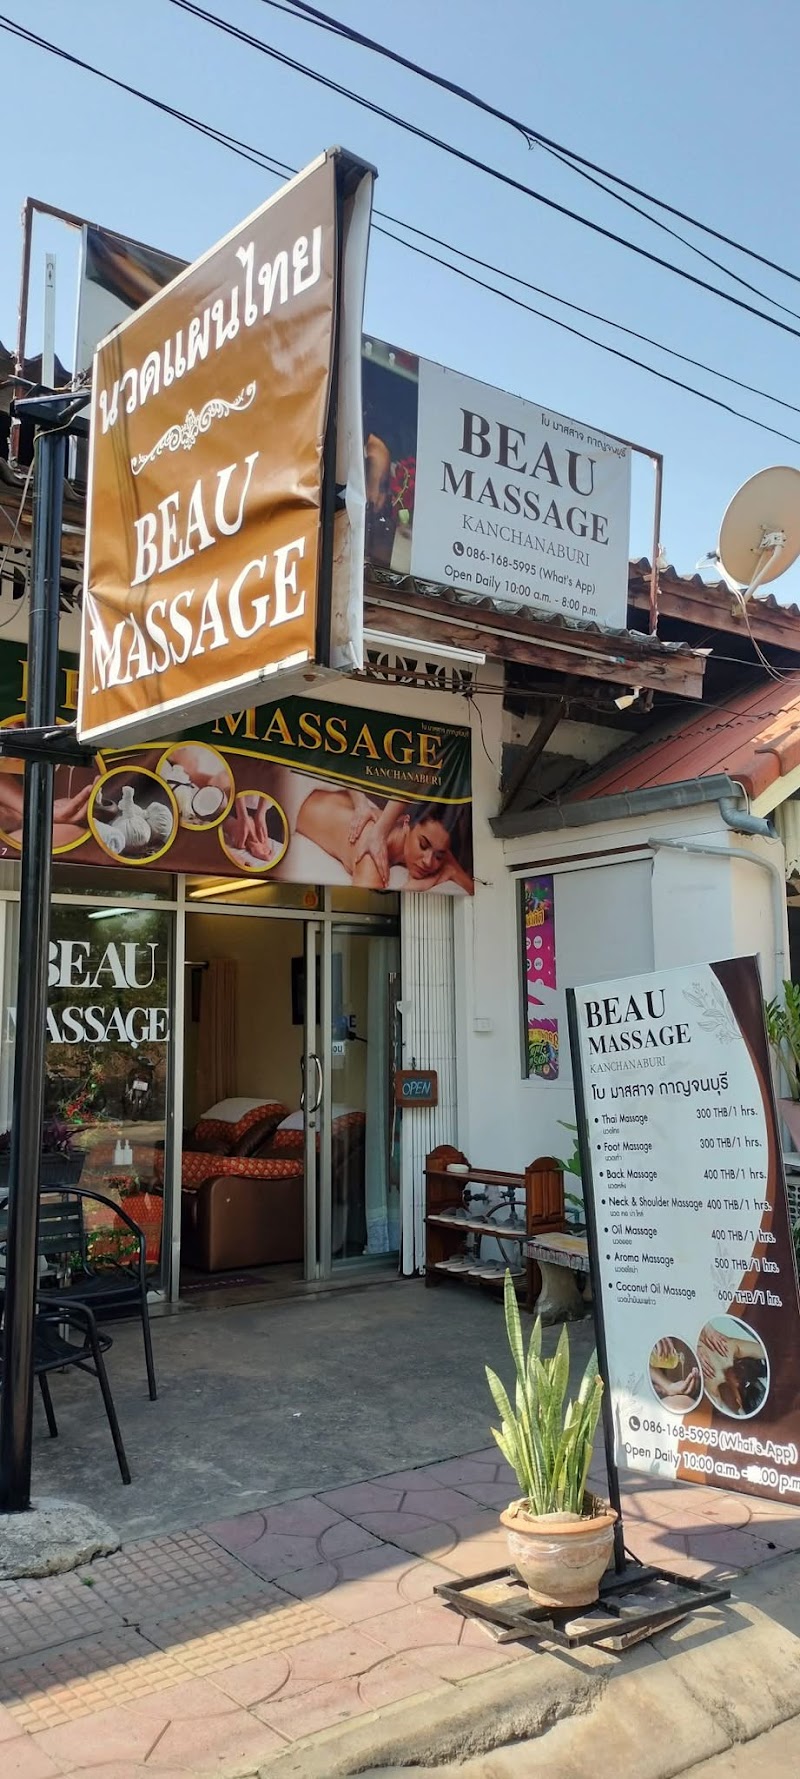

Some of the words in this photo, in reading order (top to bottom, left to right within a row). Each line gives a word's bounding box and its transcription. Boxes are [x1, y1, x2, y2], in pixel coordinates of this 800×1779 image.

[99, 225, 322, 435] นวดแผนไทย
[541, 413, 550, 427] โบ
[458, 408, 596, 496] BEAU
[131, 451, 259, 587] BEAU
[440, 461, 609, 545] MASSAGE
[462, 514, 590, 567] KANCHANABURI
[466, 546, 536, 575] 086-168-5995
[539, 567, 573, 586] (What's
[575, 578, 596, 595] App)
[444, 564, 472, 582] Open
[475, 573, 501, 593] Daily
[505, 580, 531, 597] 10:00
[533, 591, 551, 603] a.m.
[561, 596, 580, 611] 8:00
[582, 605, 598, 617] p.m.
[90, 536, 305, 694] MASSAGE
[211, 707, 444, 769] MASSAGE
[365, 765, 442, 786] KANCHANABURI
[584, 988, 666, 1029] BEAU
[588, 1022, 692, 1055] MASSAGE
[590, 1056, 666, 1074] KANCHANABURI
[402, 1081, 431, 1096] OPEN
[591, 1084, 606, 1100] โบ
[610, 1083, 655, 1099] มาสสาจ
[659, 1071, 729, 1097] กาญจนบุรี
[601, 1113, 618, 1124] Thai
[619, 1113, 649, 1126] Massage
[696, 1108, 712, 1119] 300
[713, 1105, 738, 1118] THB/1
[740, 1104, 758, 1116] hrs.
[603, 1142, 620, 1152] Foot
[622, 1141, 653, 1154] Massage
[699, 1138, 715, 1149] 300
[716, 1136, 741, 1148] THB/1
[744, 1135, 762, 1147] hrs.
[606, 1168, 625, 1179] Back
[626, 1169, 658, 1182] Massage
[703, 1169, 719, 1180] 400
[720, 1168, 746, 1180] THB/1
[749, 1167, 767, 1179] hrs.
[608, 1196, 629, 1207] Neck
[631, 1197, 638, 1206] &
[639, 1196, 670, 1207] Shoulder
[671, 1198, 703, 1211] Massage
[707, 1199, 722, 1210] 400
[723, 1199, 750, 1210] THB/1
[754, 1199, 772, 1211] hrs.
[611, 1224, 623, 1235] Oil
[624, 1225, 658, 1239] Massage
[711, 1229, 726, 1240] 400
[727, 1229, 755, 1241] THB/1
[758, 1228, 776, 1243] hrs.
[614, 1252, 639, 1262] Aroma
[641, 1253, 675, 1268] Massage
[714, 1257, 730, 1269] 500
[731, 1257, 760, 1272] THB/1
[762, 1257, 779, 1273] hrs.
[615, 1281, 648, 1293] Coconut
[650, 1282, 661, 1294] Oil
[663, 1284, 696, 1300] Massage
[717, 1290, 733, 1301] 600
[735, 1290, 765, 1304] THB/1
[767, 1290, 782, 1306] hrs.
[643, 1419, 717, 1444] 086-168-5995
[720, 1432, 762, 1453] (What's
[767, 1442, 797, 1463] App)
[625, 1442, 651, 1459] Open
[654, 1447, 680, 1468] Daily
[684, 1454, 713, 1471] 10:00
[716, 1464, 739, 1477] a.m.
